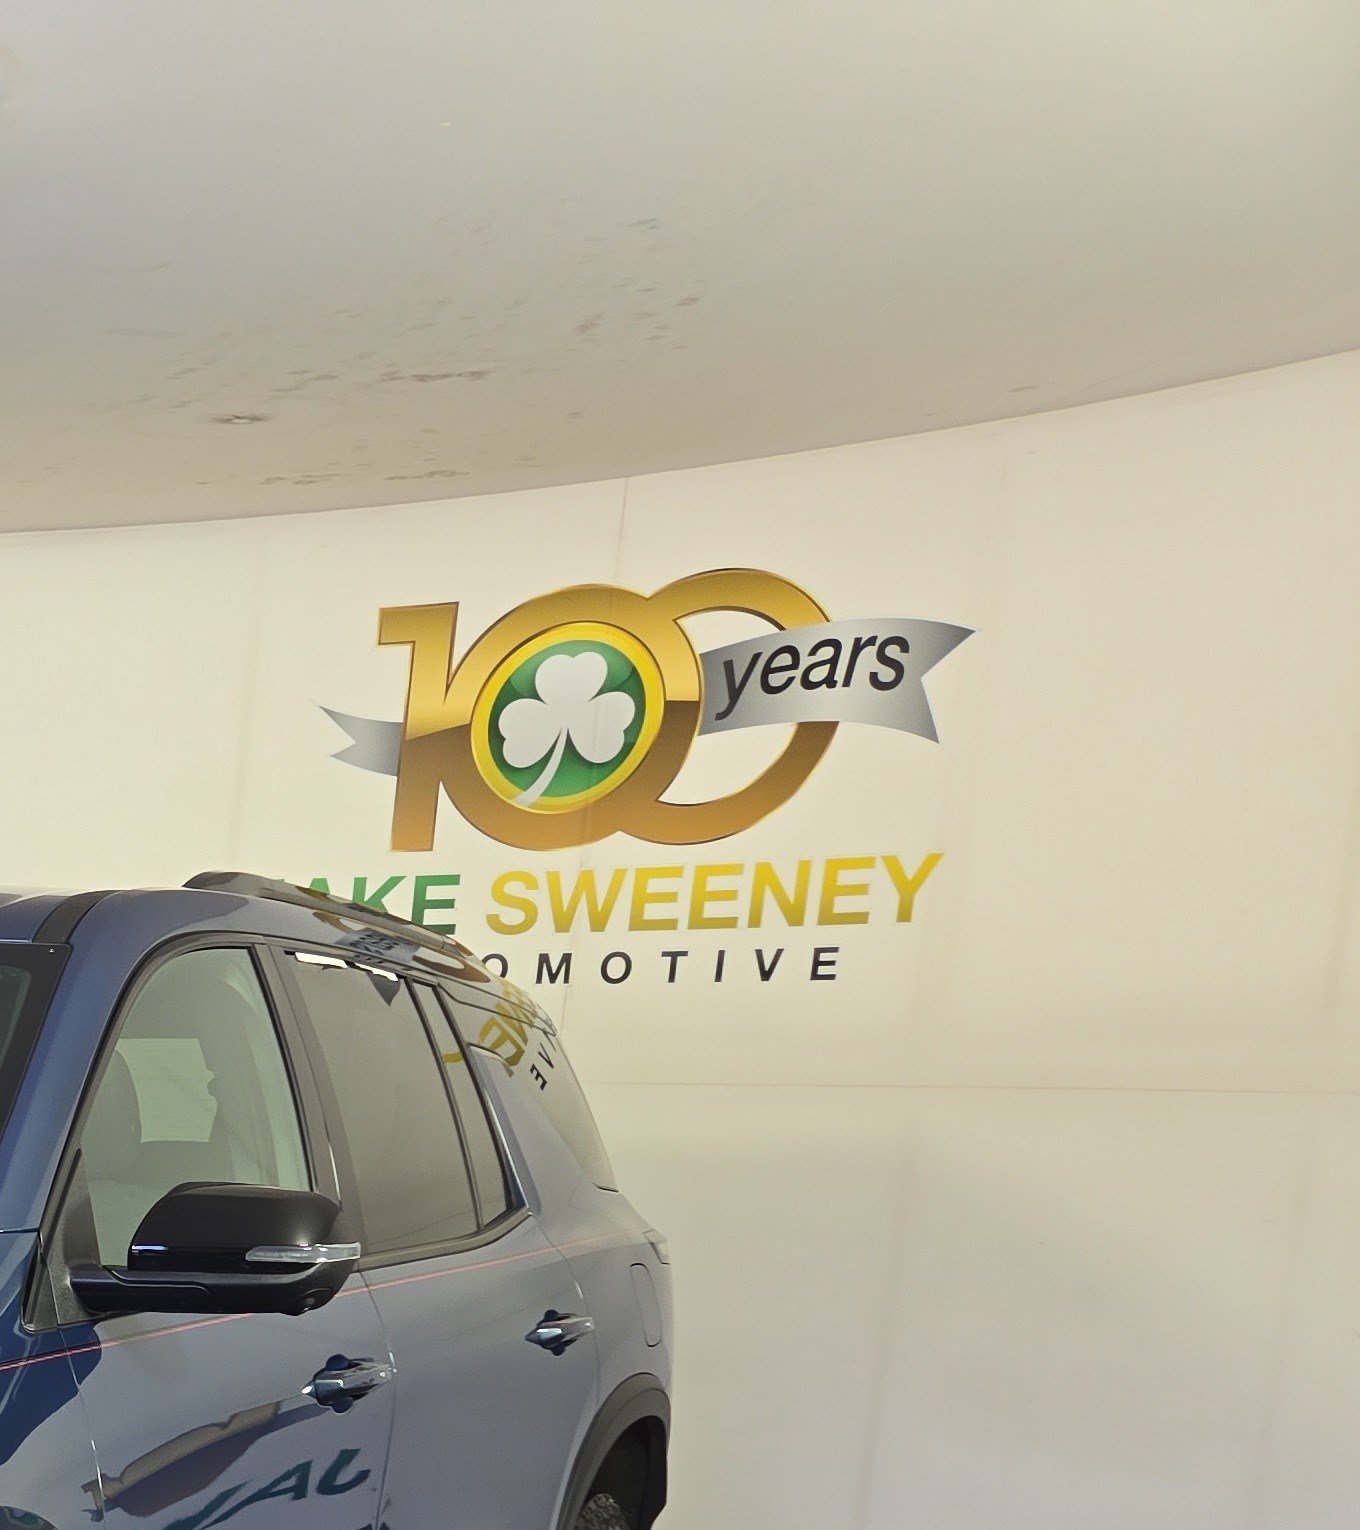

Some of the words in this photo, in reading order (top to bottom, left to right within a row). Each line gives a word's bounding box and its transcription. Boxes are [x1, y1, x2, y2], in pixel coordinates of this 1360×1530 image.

[378, 567, 840, 853] 100
[714, 634, 910, 721] years
[486, 852, 945, 935] SWEENEY
[482, 946, 840, 984] OMOTIVE
